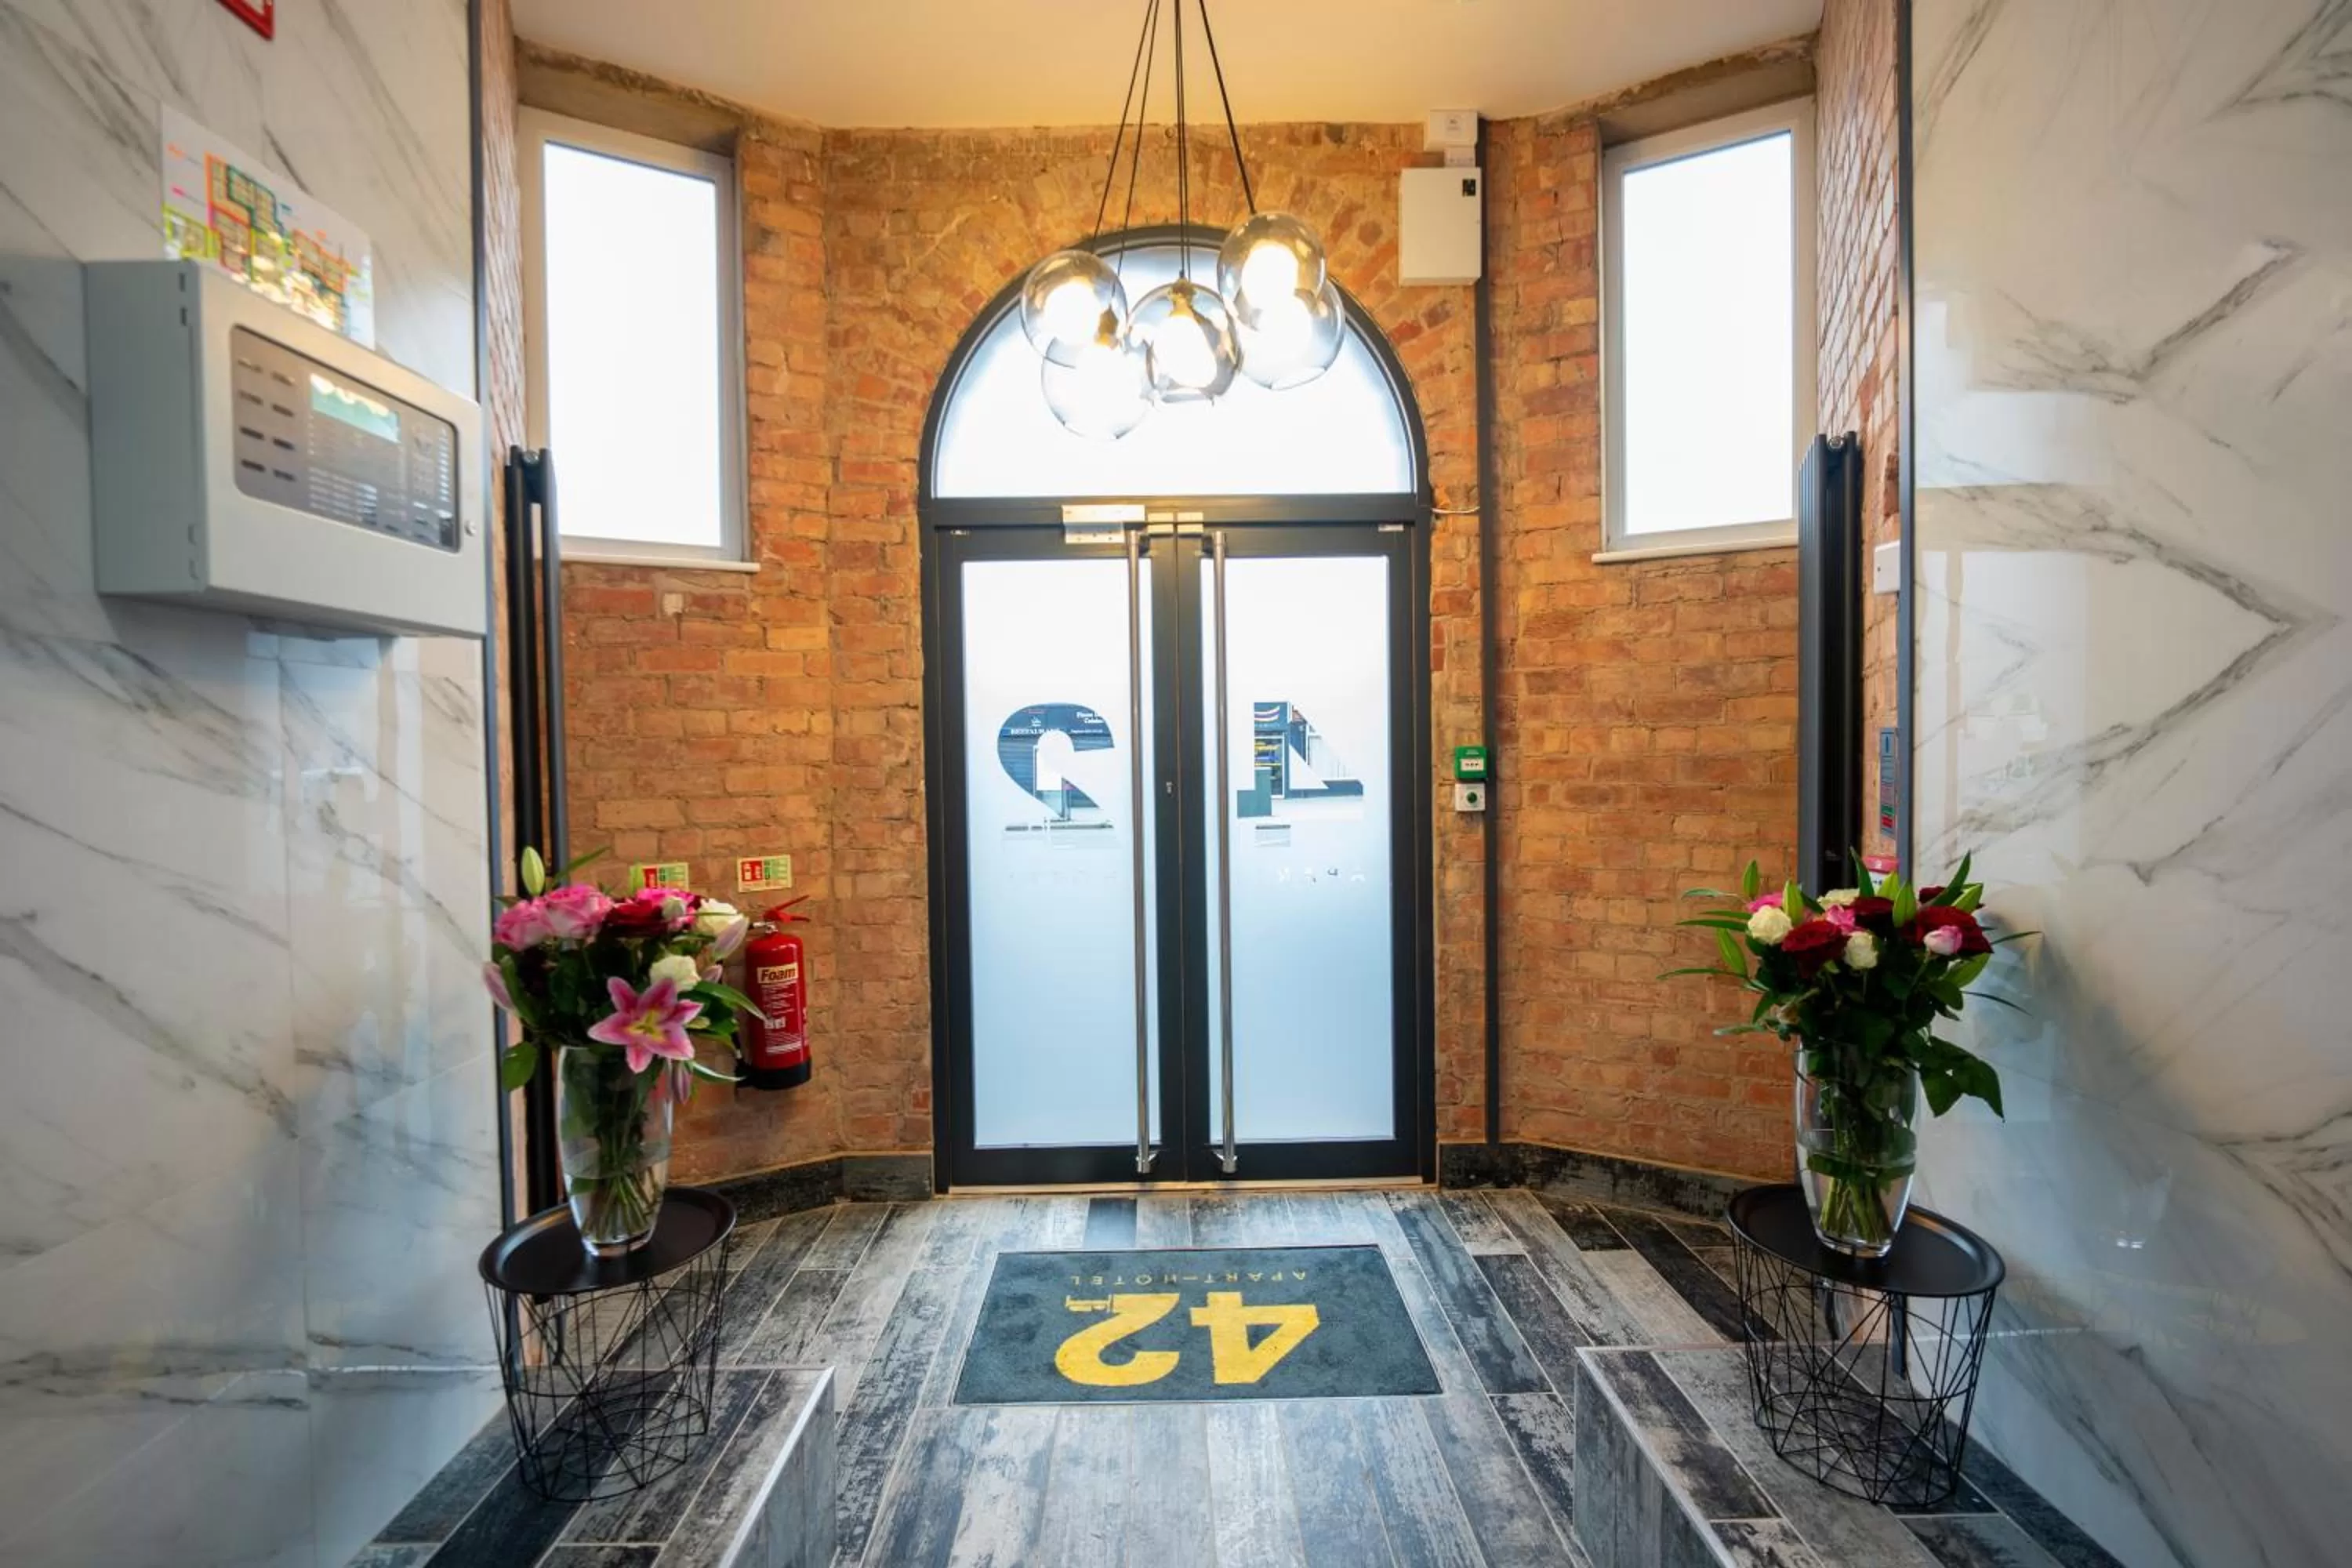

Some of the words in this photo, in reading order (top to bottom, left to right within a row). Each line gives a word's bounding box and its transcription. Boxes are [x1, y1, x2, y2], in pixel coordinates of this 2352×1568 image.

[760, 967, 796, 982] Foam
[1070, 1271, 1306, 1286] APART-HOTEL
[1055, 1290, 1320, 1387] 42
